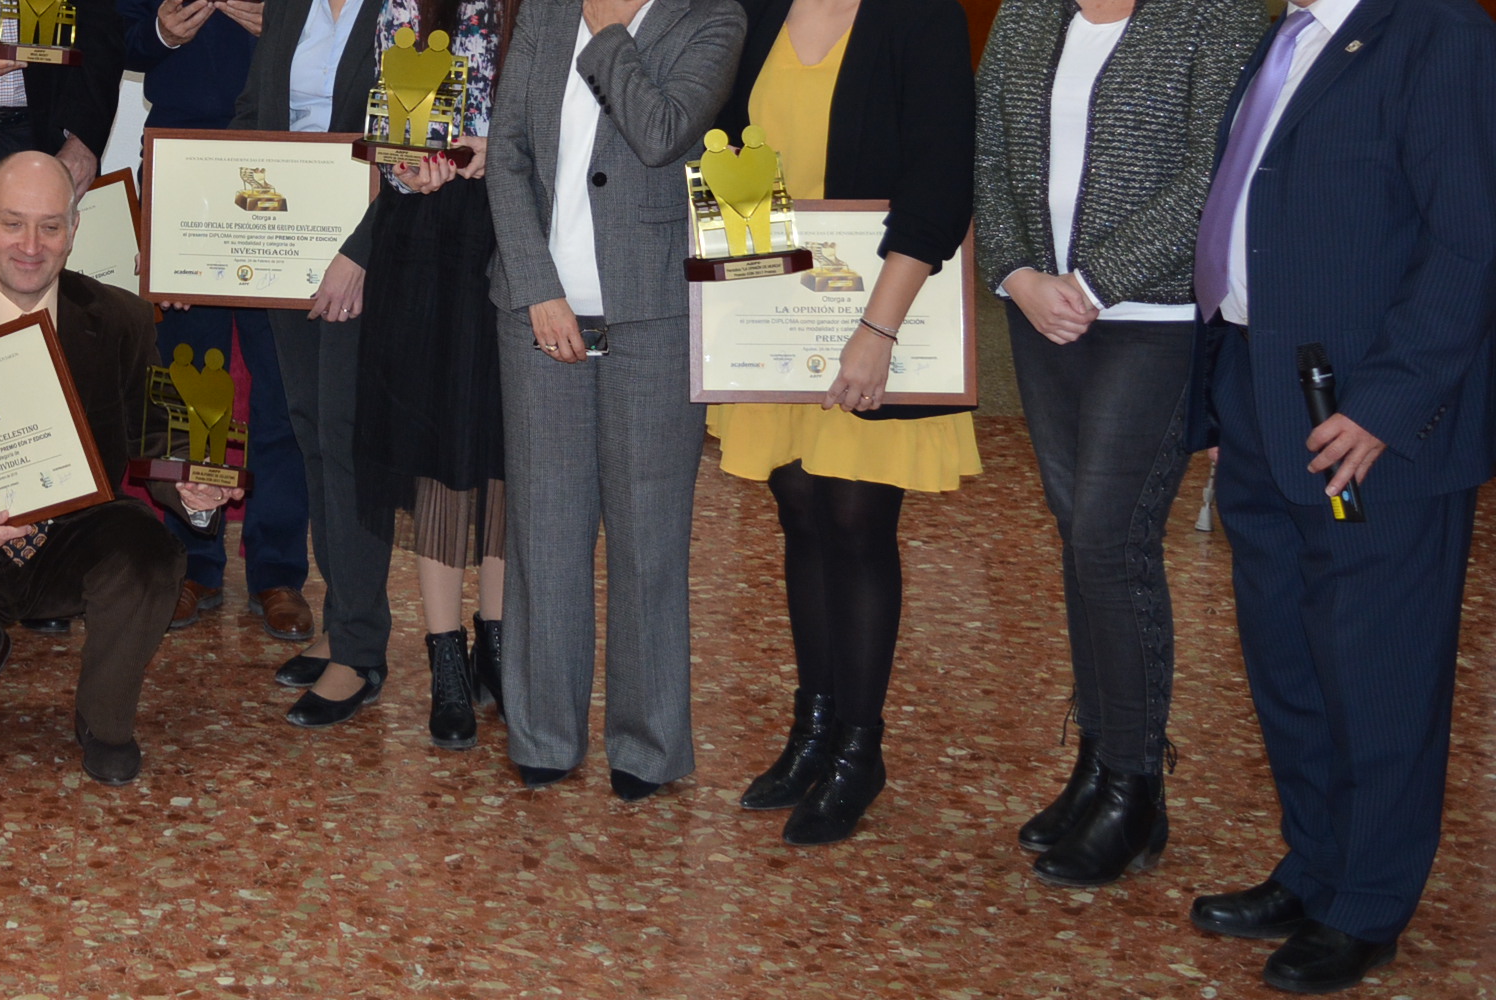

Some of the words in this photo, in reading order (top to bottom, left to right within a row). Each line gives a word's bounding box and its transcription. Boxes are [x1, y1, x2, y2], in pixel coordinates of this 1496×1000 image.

[235, 222, 266, 230] PSICÓLOGOS
[296, 225, 342, 233] ENVEJECIMIENTO
[231, 247, 299, 256] INVESTIGACIÓN
[95, 269, 115, 279] EDICIÓN
[793, 305, 834, 314] OPINIÓN
[0, 443, 18, 453] PREMIO
[32, 432, 52, 442] EDICIÓN
